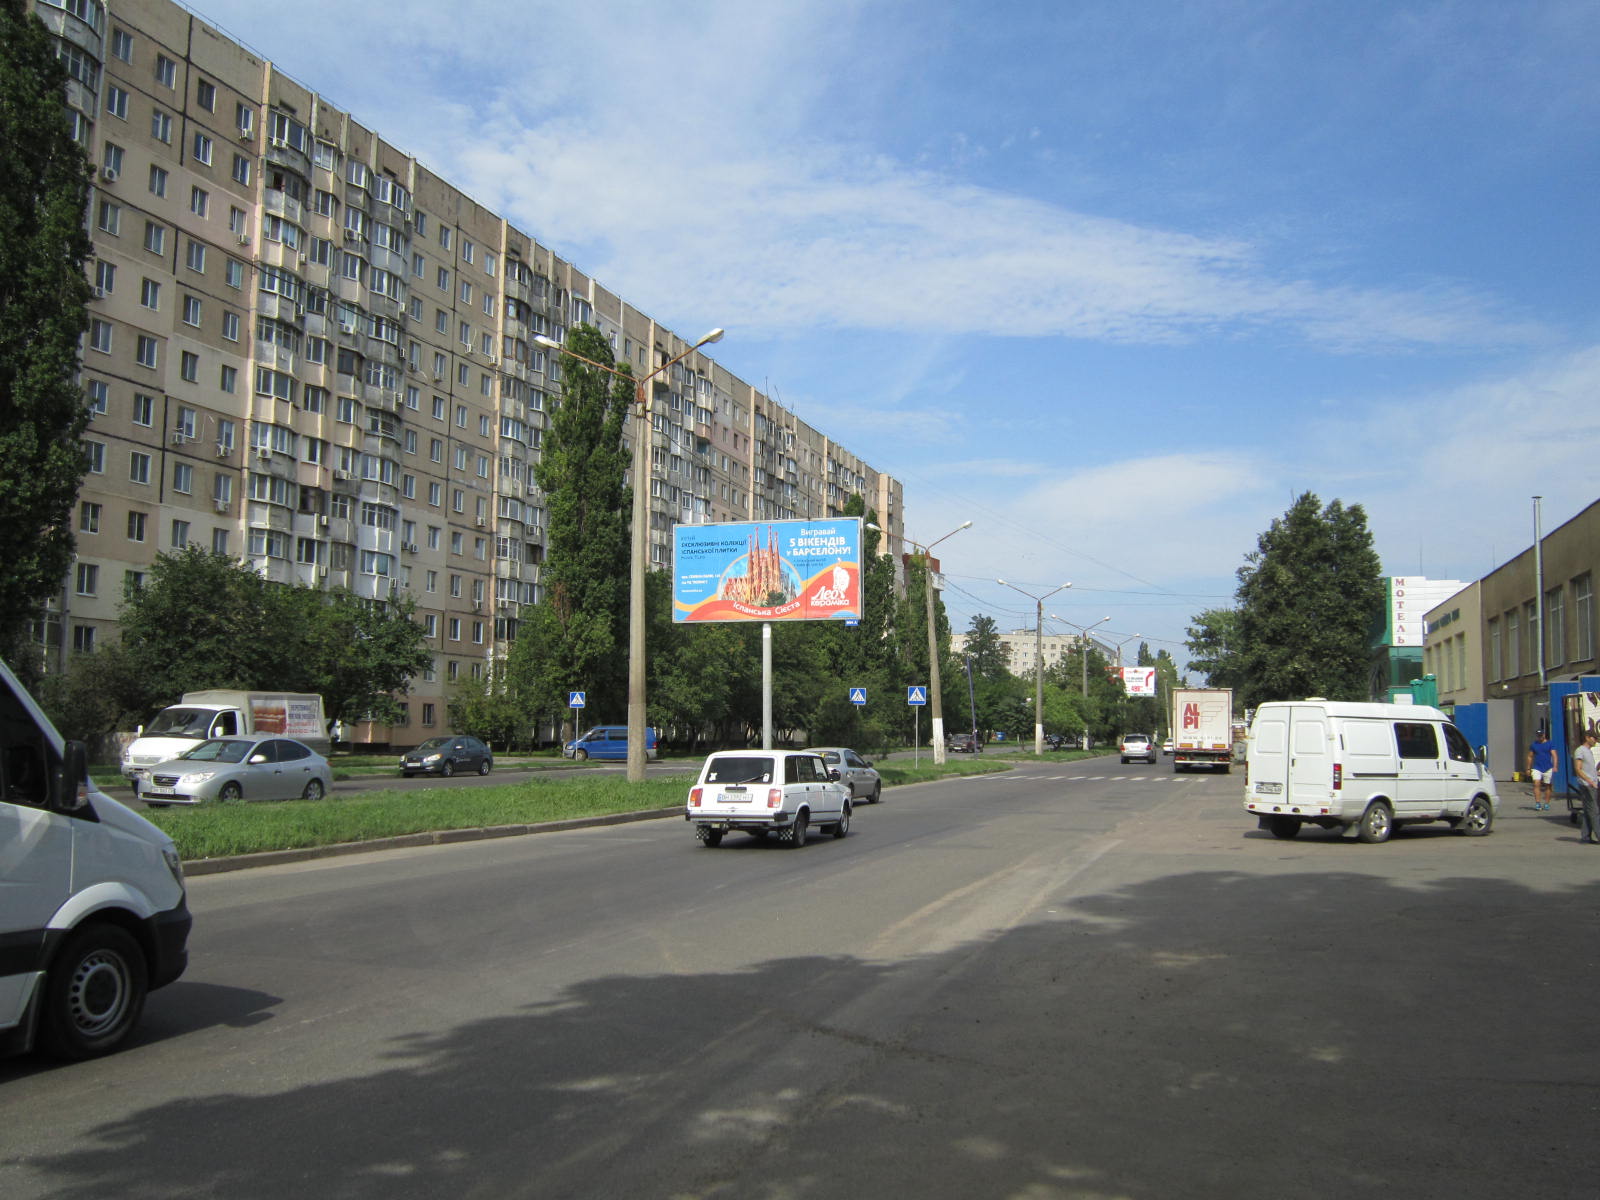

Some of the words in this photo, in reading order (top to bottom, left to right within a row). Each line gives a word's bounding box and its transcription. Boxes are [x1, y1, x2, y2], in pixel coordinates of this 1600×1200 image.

[800, 528, 836, 537] Вигравай
[789, 538, 796, 547] 5
[797, 537, 846, 547] ВІКЕНДІВ
[792, 546, 851, 556] БАРСЕЛОНУ!
[810, 586, 839, 601] Лео
[733, 601, 772, 616] Іспанська
[774, 601, 801, 615] Сієста
[1395, 578, 1406, 644] МОТЕЛЬ
